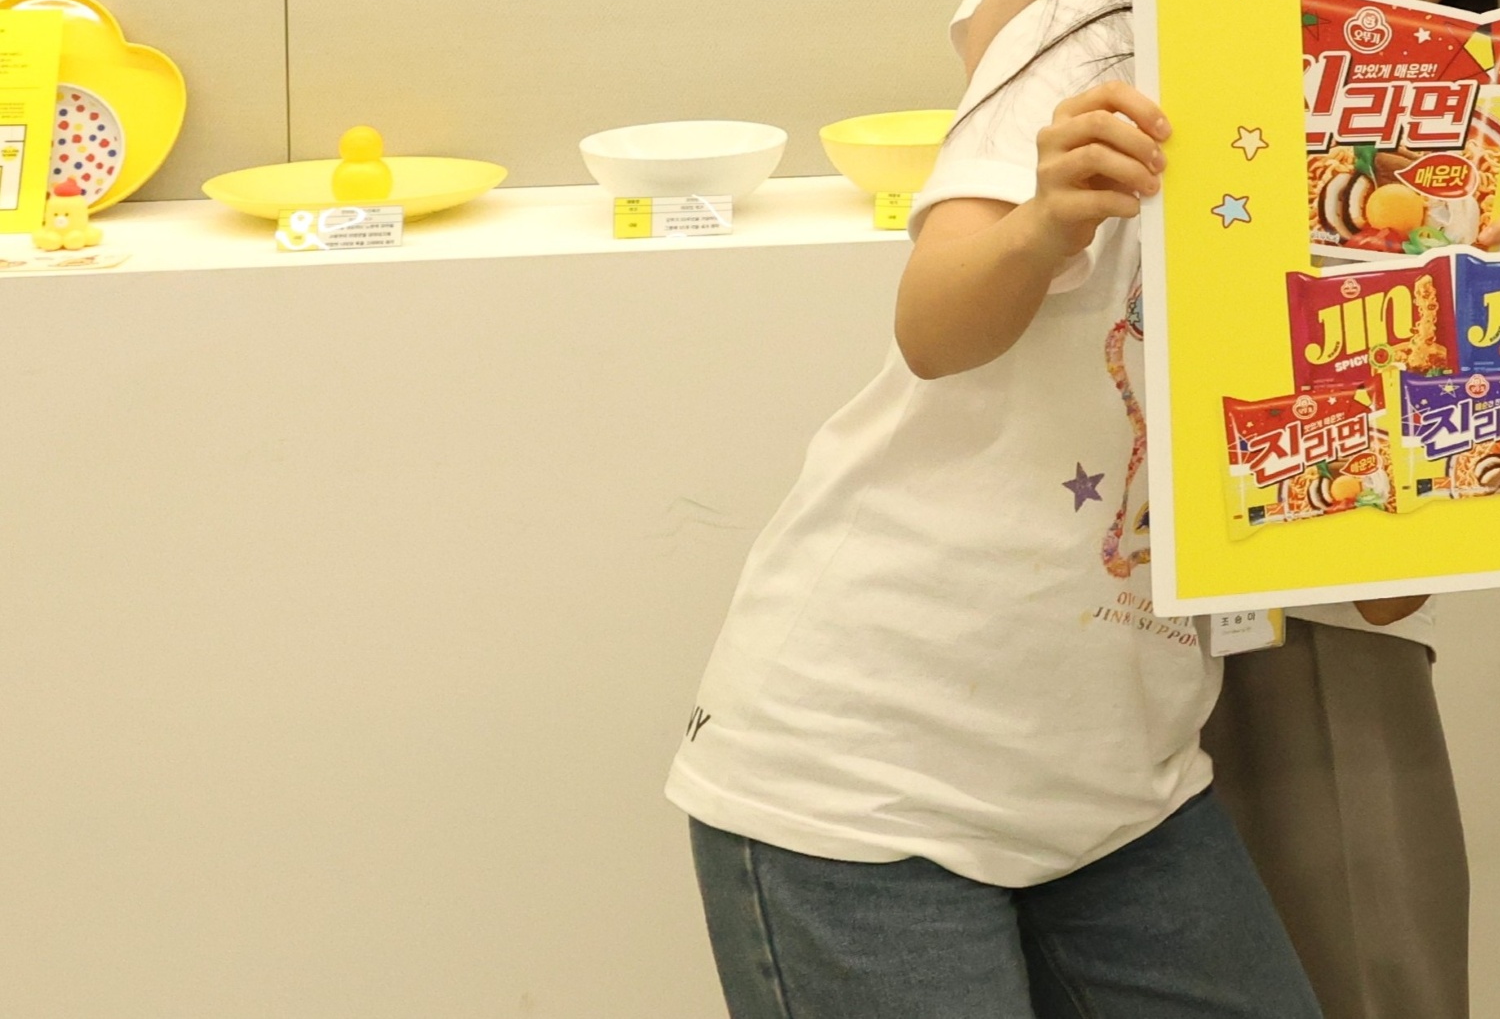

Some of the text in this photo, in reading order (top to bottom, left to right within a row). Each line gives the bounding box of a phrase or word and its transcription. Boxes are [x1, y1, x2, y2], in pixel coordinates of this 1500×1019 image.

[1353, 29, 1381, 44] 오뚜기
[1353, 63, 1438, 79] 맛있게 매운맛!
[1415, 165, 1468, 188] 매운맛
[1334, 354, 1369, 373] SPICY
[1249, 414, 1369, 487] 진라면
[1350, 456, 1376, 473] 매운맛
